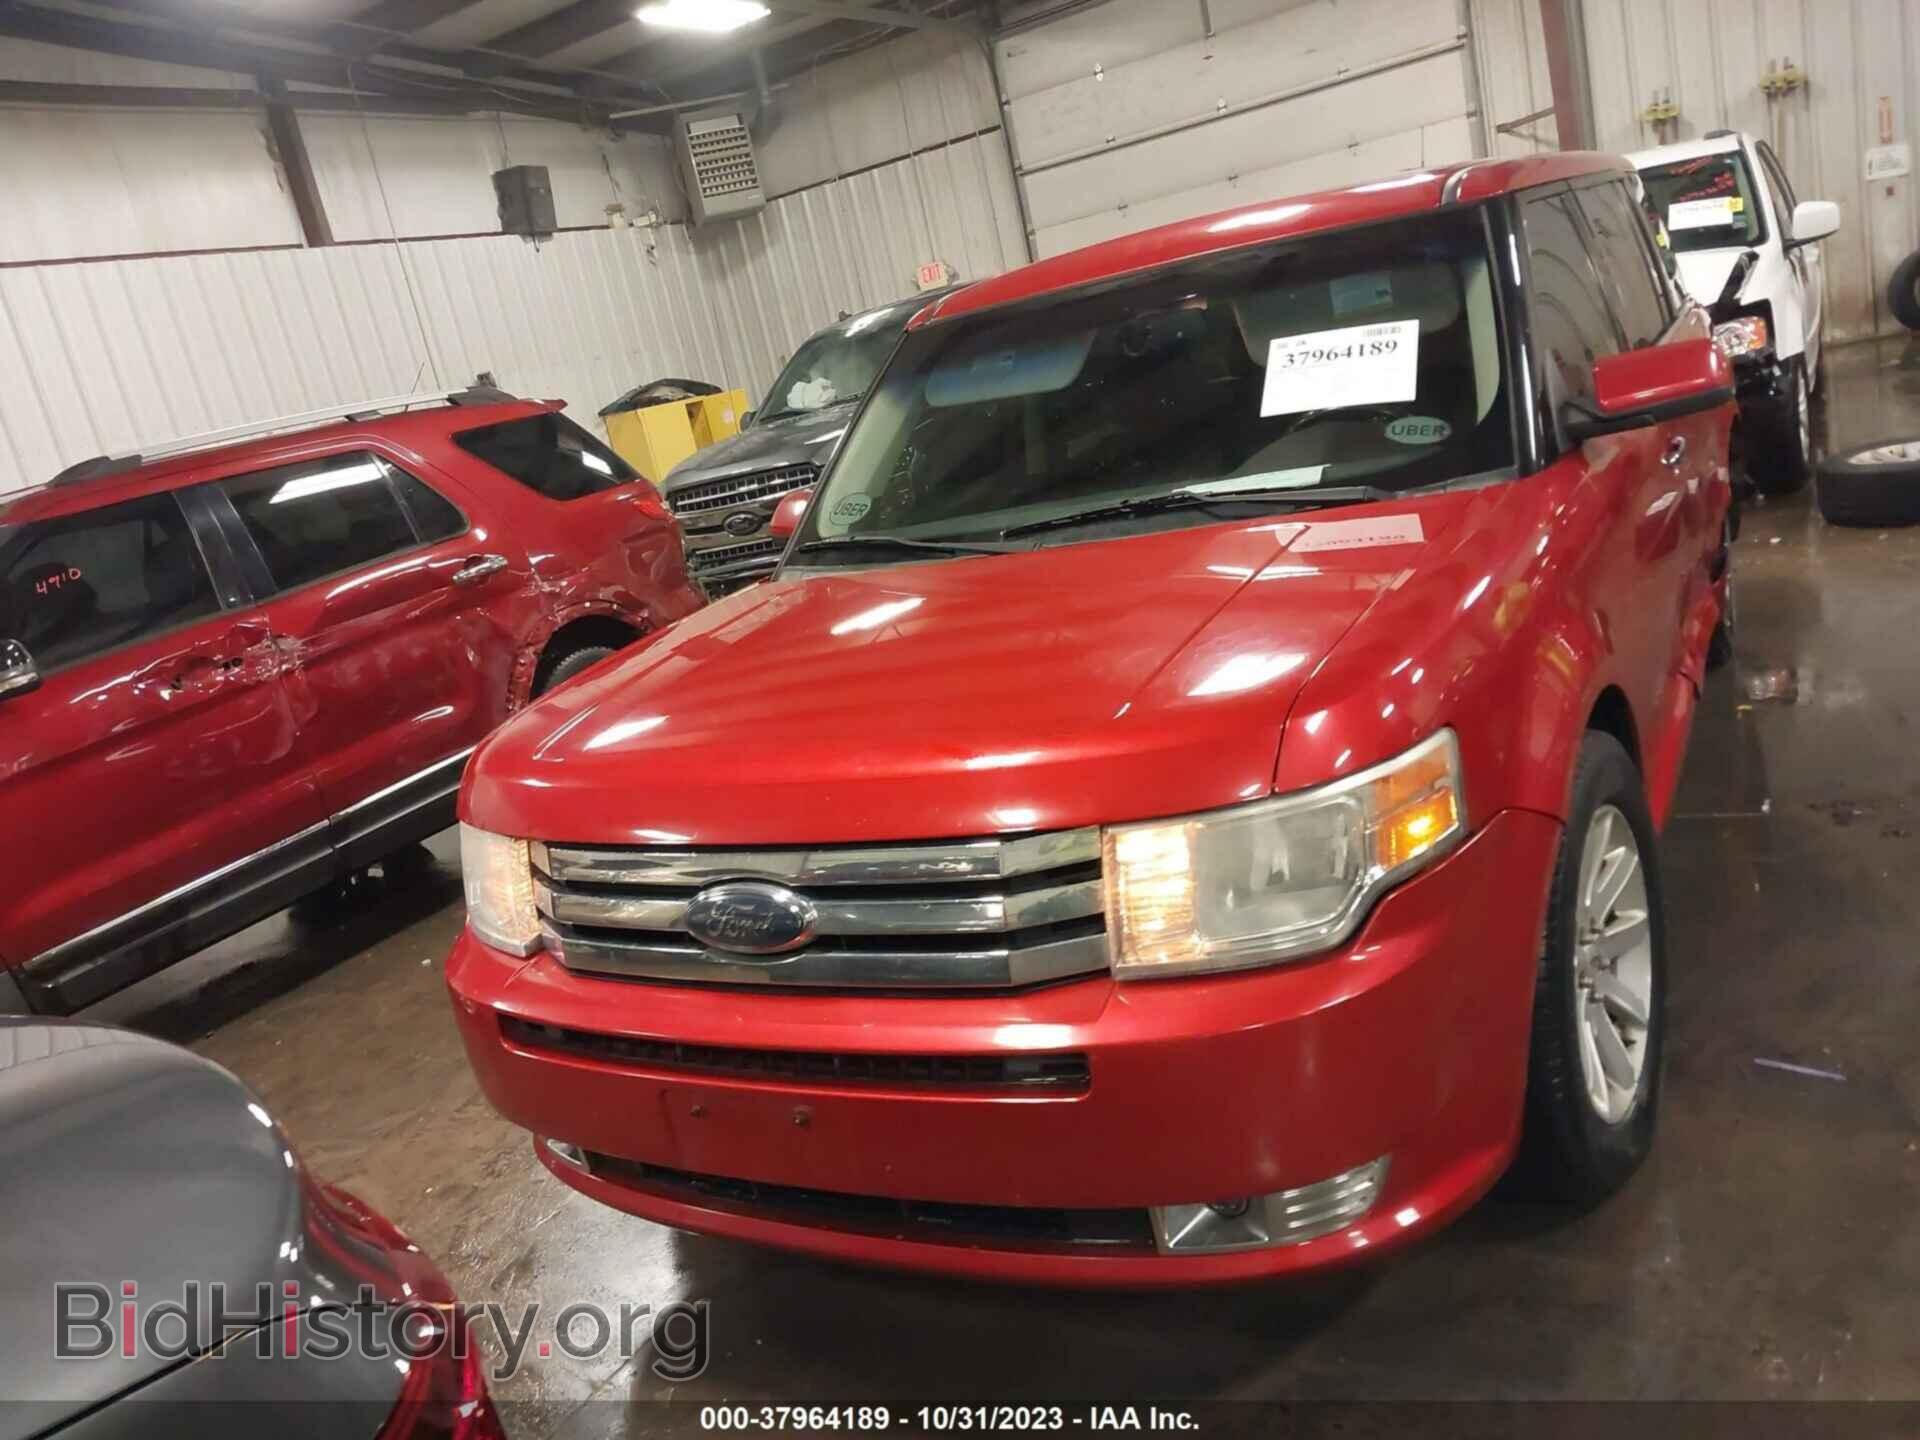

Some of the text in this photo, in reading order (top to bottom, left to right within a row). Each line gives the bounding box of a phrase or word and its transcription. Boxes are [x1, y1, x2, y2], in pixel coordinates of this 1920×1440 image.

[921, 263, 943, 284] EXIT
[1281, 339, 1399, 369] 37964189
[1391, 423, 1447, 437] UBER
[832, 501, 869, 516] UBER
[35, 567, 81, 594] 4910
[706, 899, 775, 937] Ford
